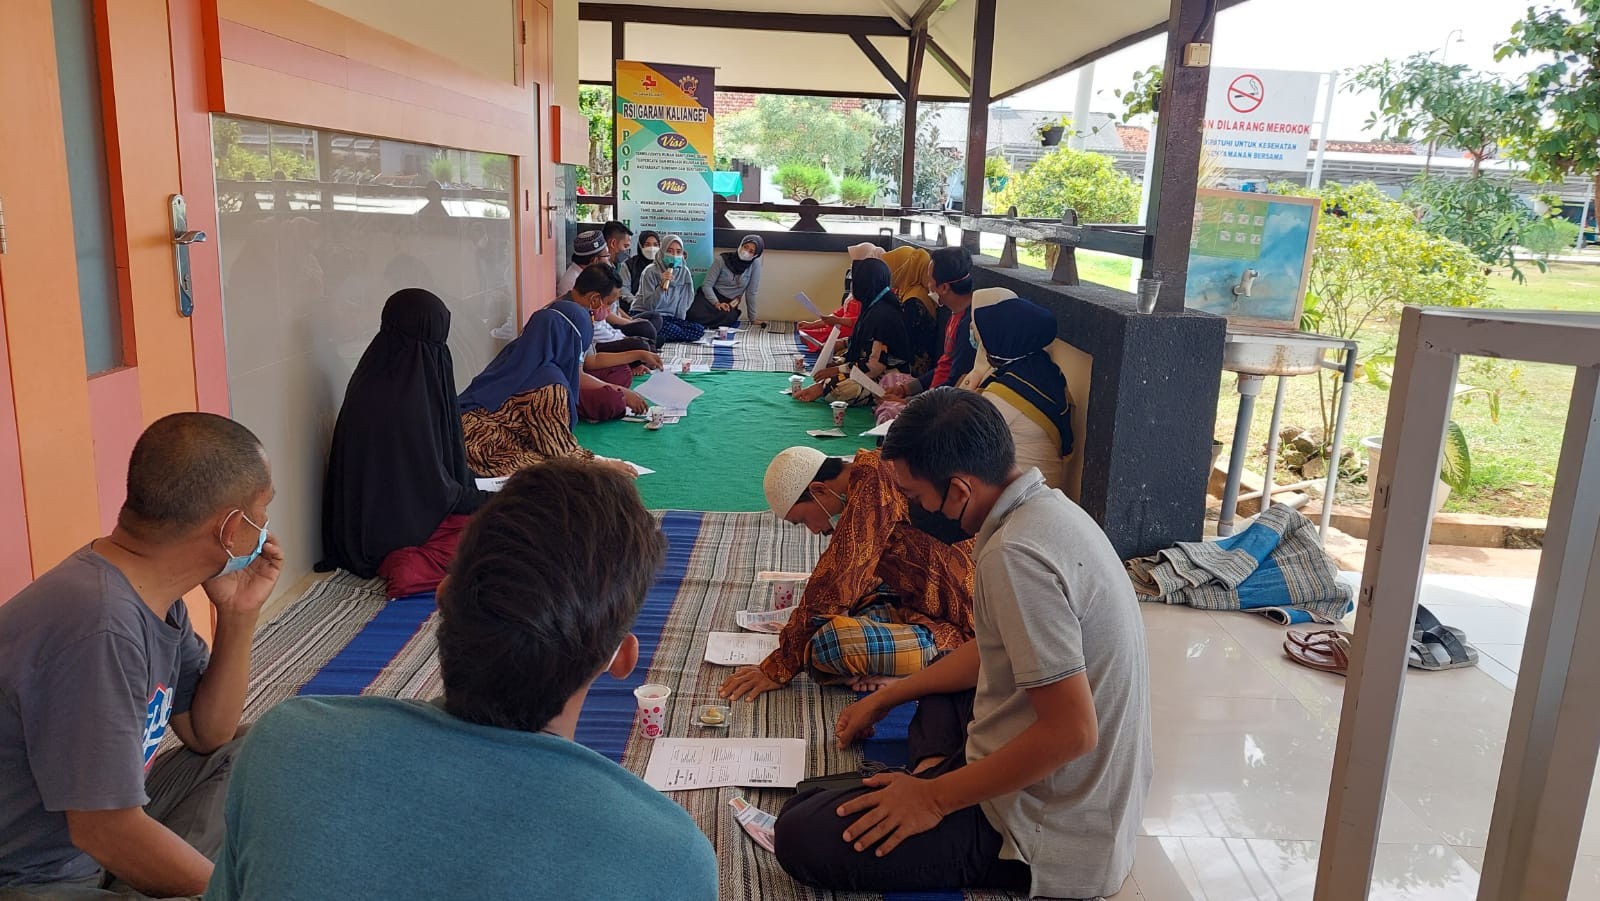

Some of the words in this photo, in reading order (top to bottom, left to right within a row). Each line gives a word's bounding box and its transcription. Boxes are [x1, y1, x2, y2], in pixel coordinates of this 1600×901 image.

[623, 104, 636, 118] RSI
[638, 105, 665, 119] GARAM
[666, 107, 707, 122] KALIANGET
[1217, 120, 1264, 132] DILARANG
[1266, 123, 1310, 134] MEROKOK
[660, 135, 685, 147] Visi
[1234, 140, 1256, 148] UNTUK
[1259, 142, 1297, 150] KESEHATAN
[1253, 152, 1284, 160] BERSAMA
[622, 130, 631, 200] POJOK
[661, 181, 686, 192] Misi
